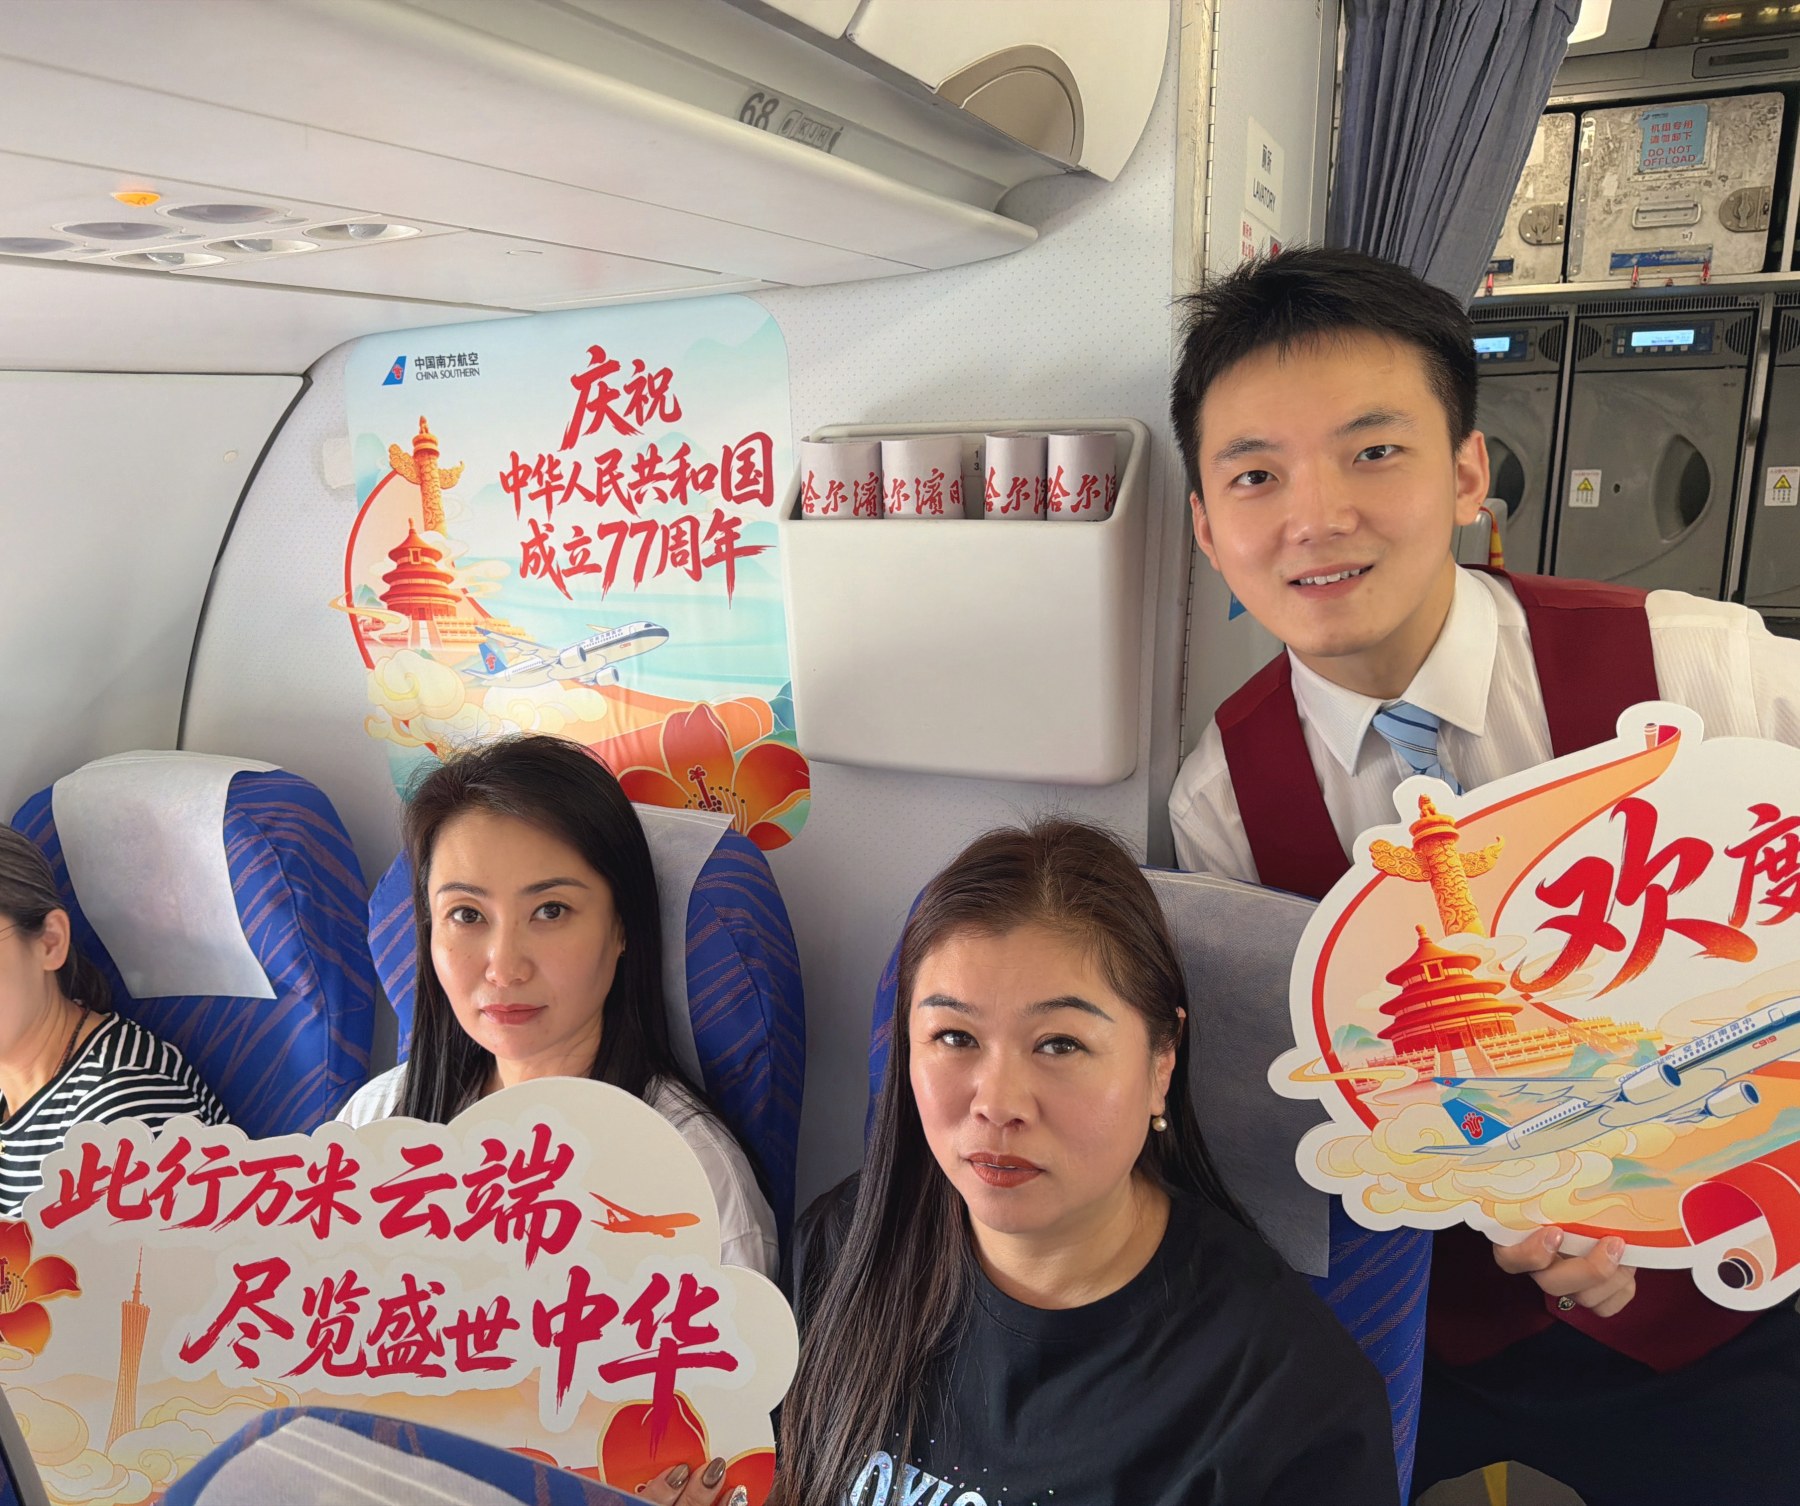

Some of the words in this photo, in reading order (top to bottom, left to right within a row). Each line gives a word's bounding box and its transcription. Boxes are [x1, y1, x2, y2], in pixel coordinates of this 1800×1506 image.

[739, 91, 780, 131] 68
[1643, 154, 1697, 167] OFFLOAD
[1648, 147, 1664, 157] DO
[1668, 145, 1692, 154] NOT
[414, 352, 479, 370] 中国南方航空
[415, 371, 438, 381] CHINA
[439, 368, 480, 379] SOUTHERN
[561, 345, 682, 452] 庆祝
[500, 431, 774, 521] 中华人民共和国
[519, 508, 777, 609] 成立77周年
[1511, 796, 1800, 1002] 欢度
[1752, 1035, 1777, 1050] C919
[40, 1122, 583, 1270] 此行万米云端
[178, 1264, 739, 1462] 尽览盛世中华
